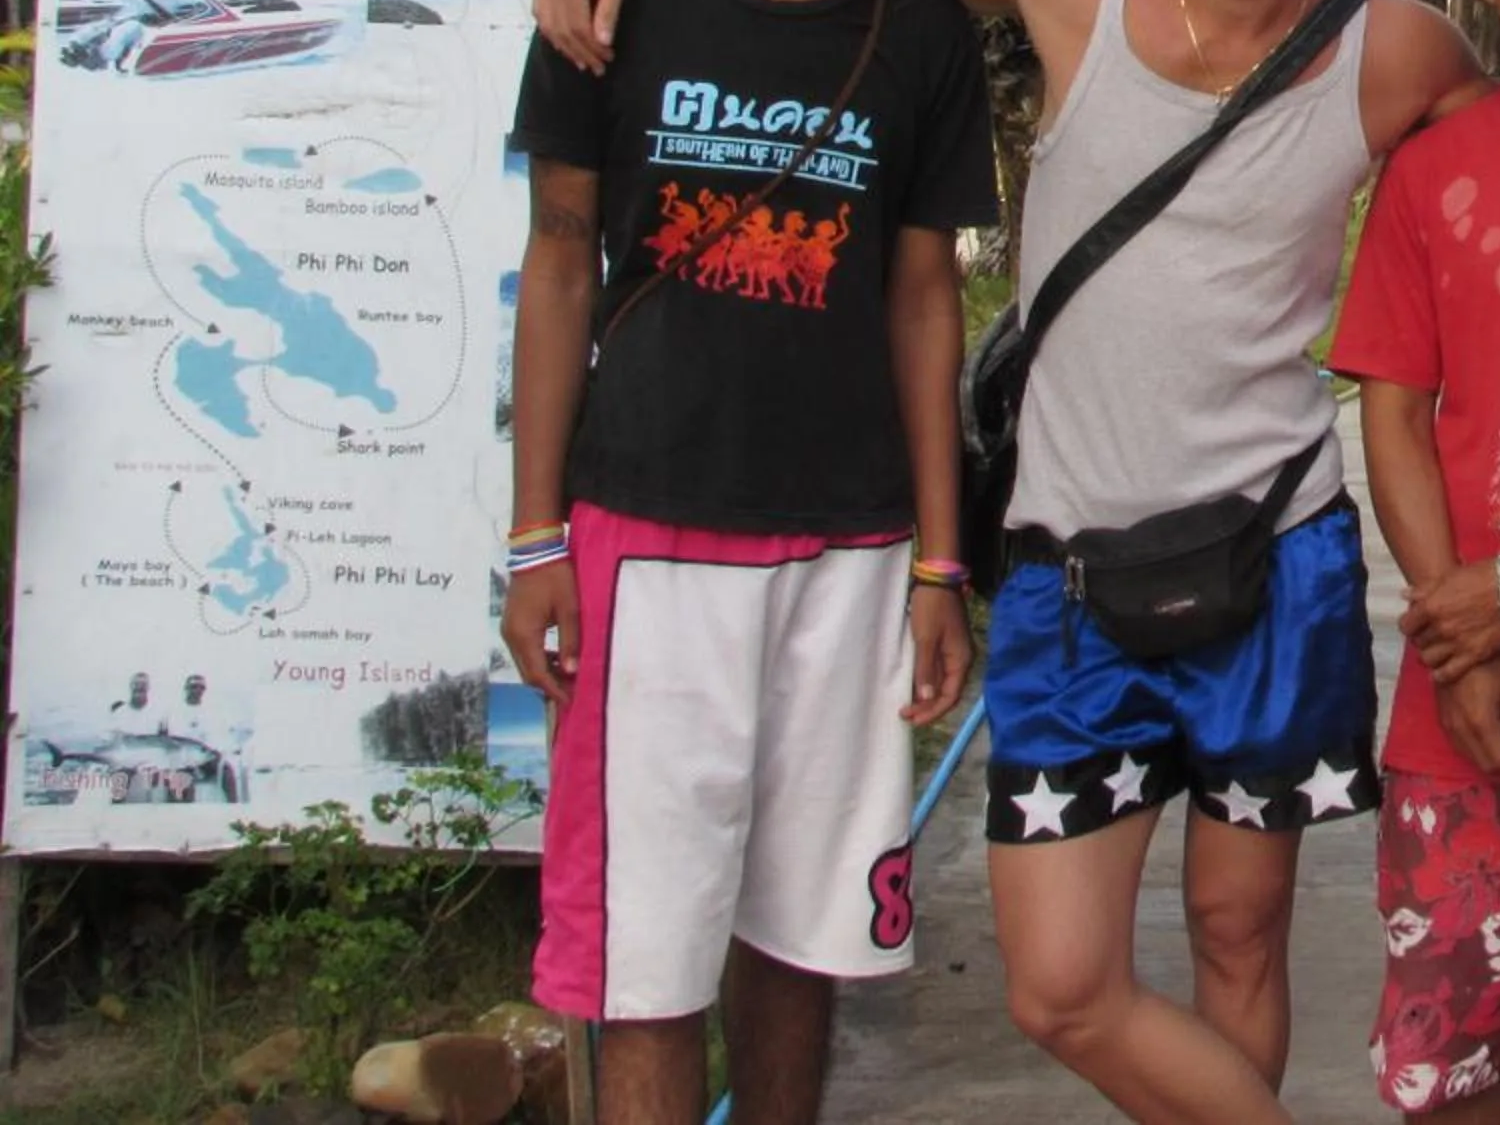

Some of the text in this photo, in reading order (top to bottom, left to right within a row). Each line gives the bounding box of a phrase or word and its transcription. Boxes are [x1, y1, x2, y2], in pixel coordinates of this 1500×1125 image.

[664, 137, 746, 162] SOUTHERN
[750, 143, 768, 166] OF
[204, 171, 324, 192] Mosquito island
[305, 197, 420, 217] Bamboo island
[297, 253, 410, 273] Phi Phi Don
[67, 314, 174, 329] Monkey beach
[415, 310, 443, 325] bay
[337, 438, 425, 457] Shark point
[267, 496, 313, 514] Viking
[341, 531, 392, 548] Lagoon
[144, 559, 171, 575] bay
[128, 574, 175, 588] beach
[333, 564, 453, 592] Phi Phi Lay
[344, 628, 372, 644] bay
[272, 658, 433, 691] Young Island
